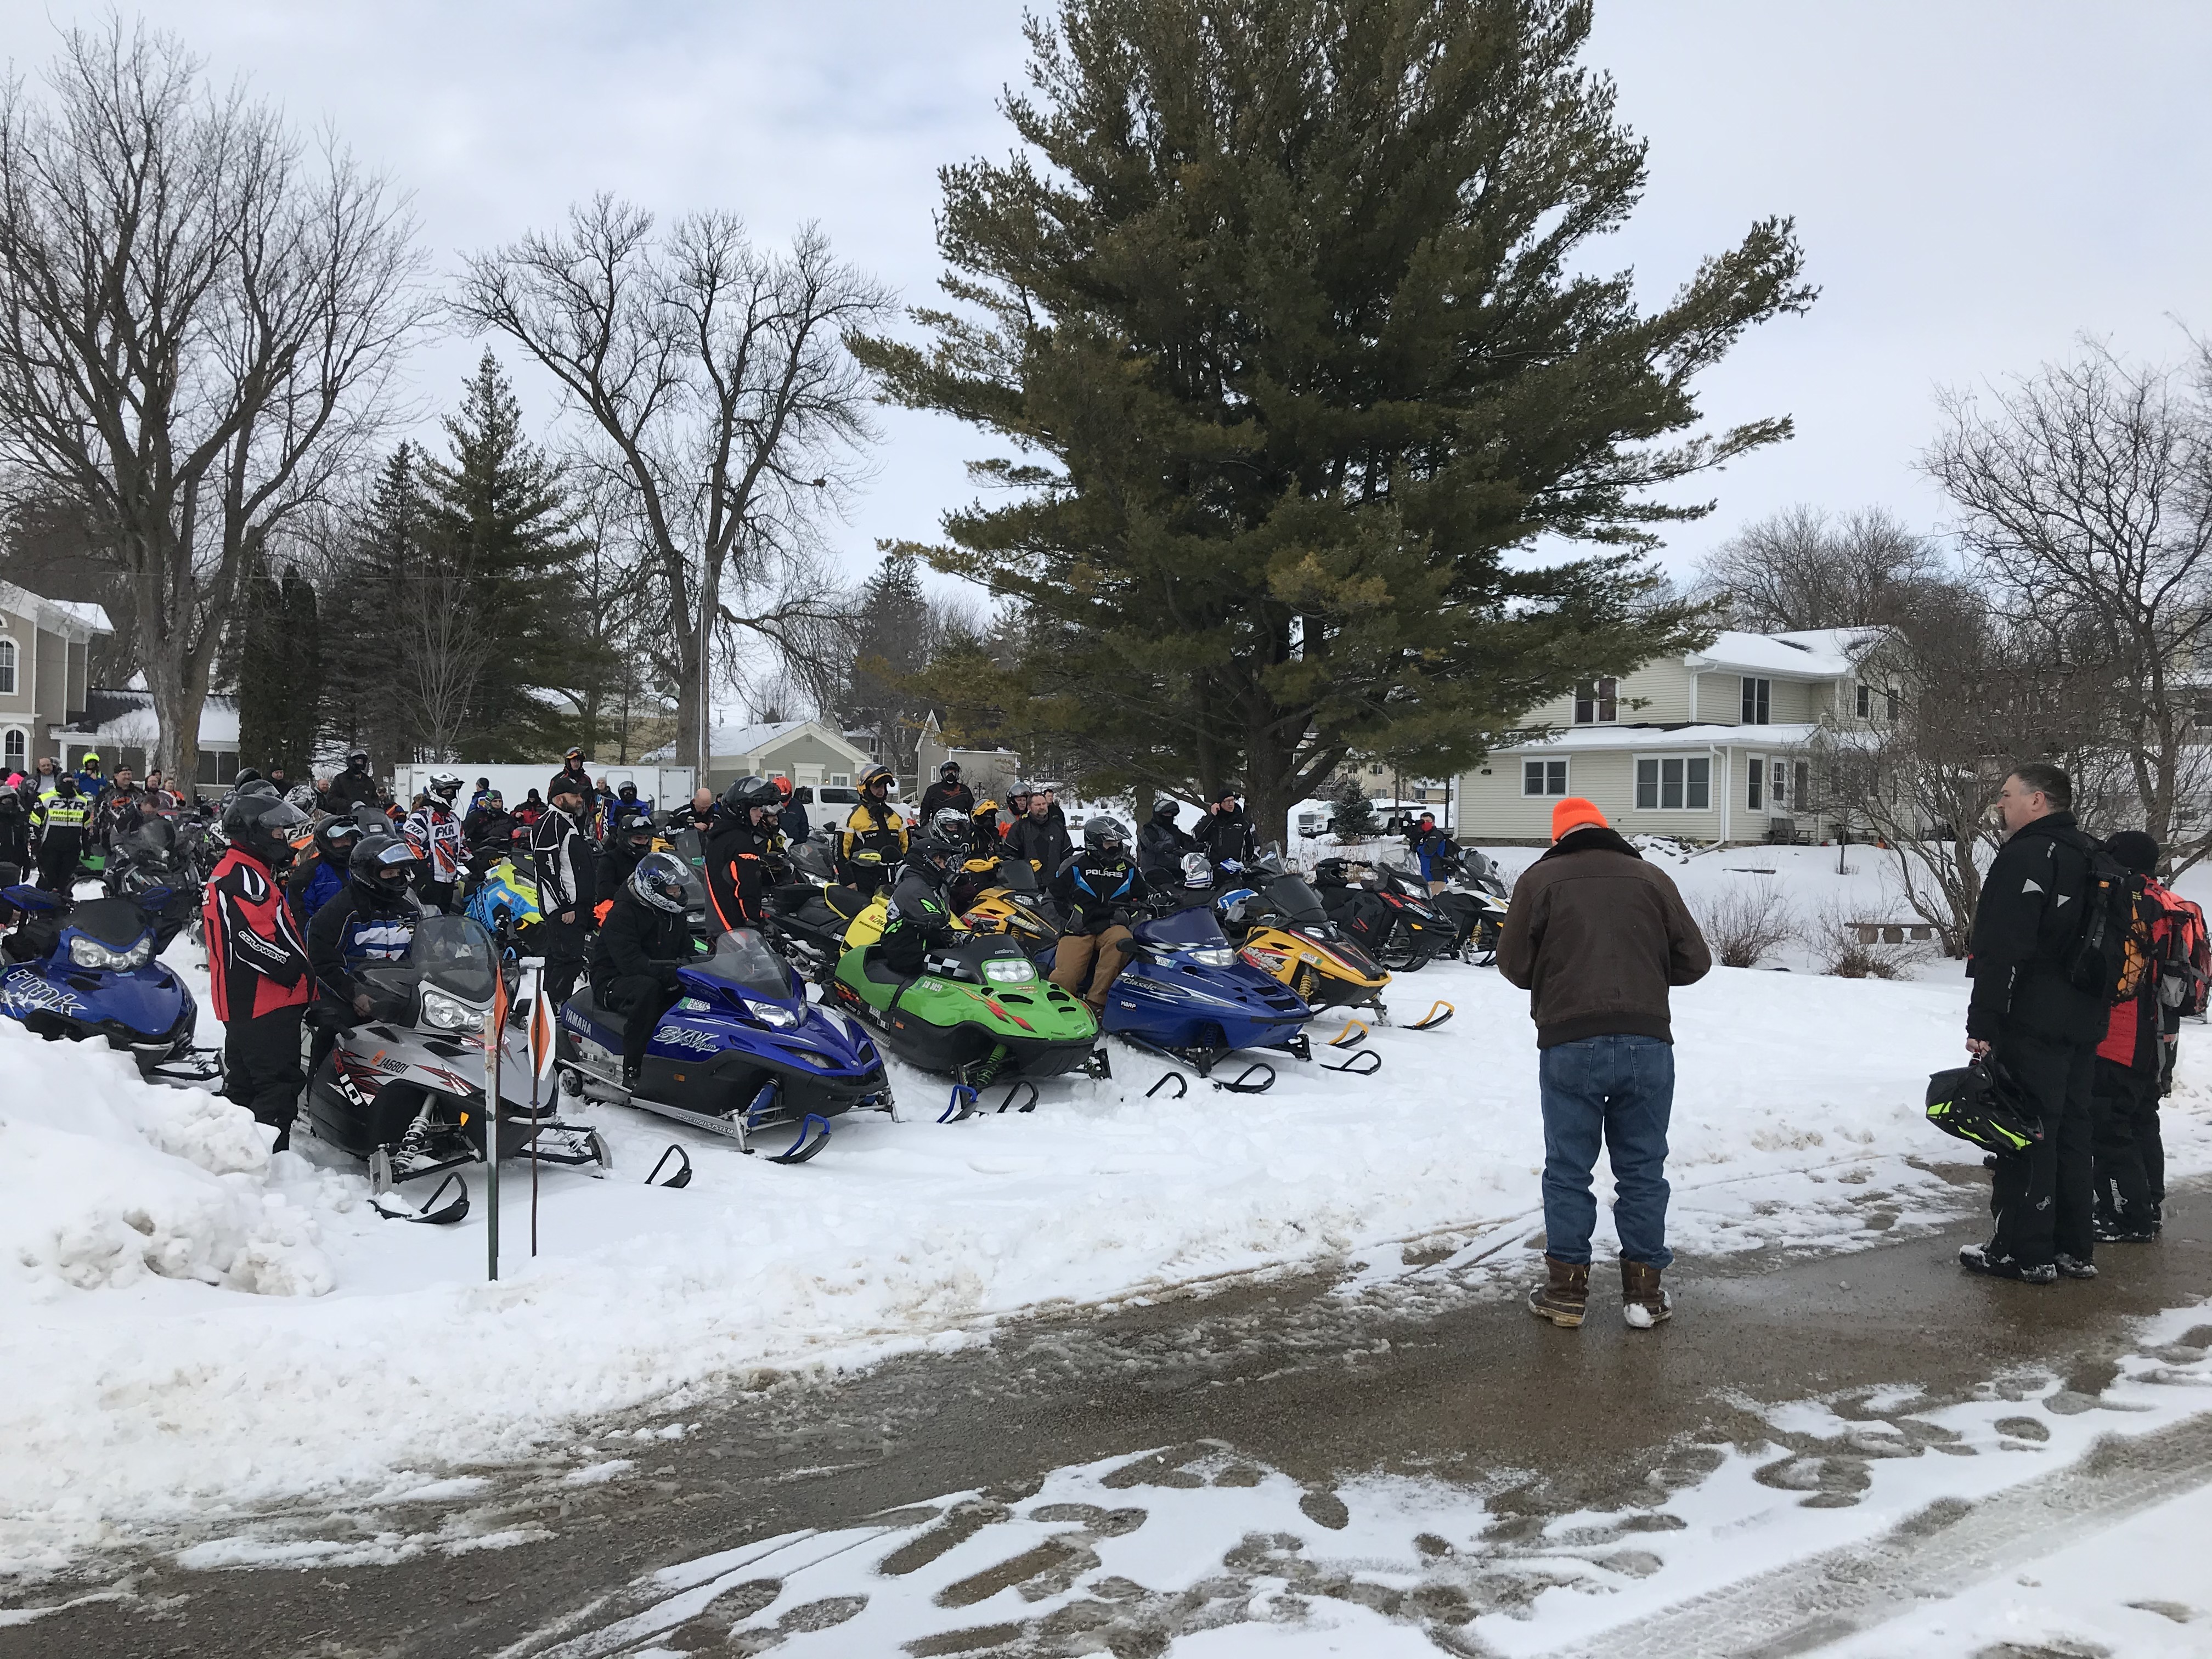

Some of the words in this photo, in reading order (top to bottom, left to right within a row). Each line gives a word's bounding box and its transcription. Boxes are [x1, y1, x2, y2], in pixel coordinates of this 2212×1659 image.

[49, 799, 85, 810] FXR
[287, 822, 315, 840] FXR
[407, 823, 424, 834] FXR
[435, 824, 454, 838] FXR
[1085, 869, 1123, 878] POLARIS
[476, 885, 492, 932] POLARIS
[1122, 978, 1157, 991] Classic
[565, 1008, 592, 1036] YAMAHA
[339, 1073, 363, 1106] IQ
[707, 1122, 734, 1135] SYSTEM
